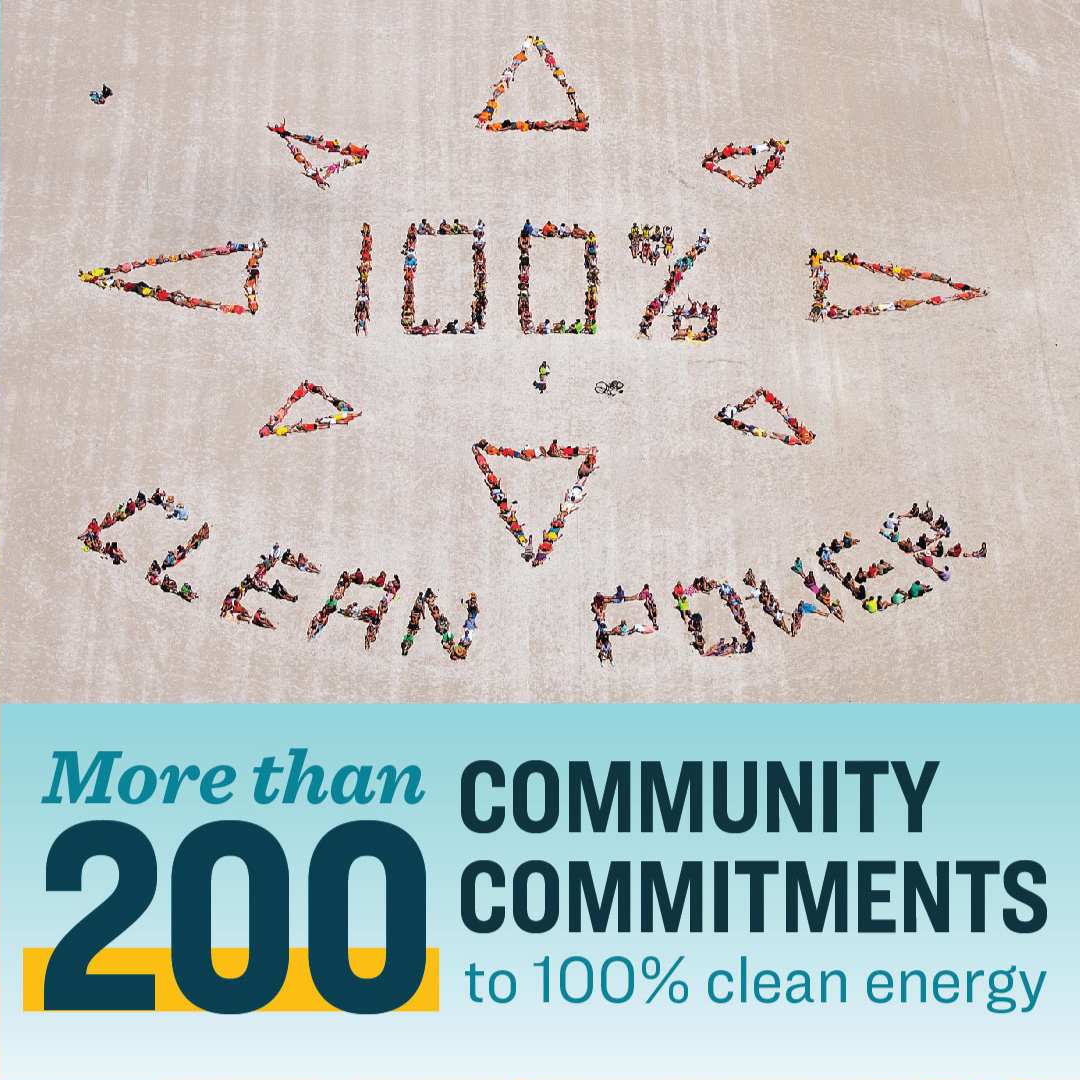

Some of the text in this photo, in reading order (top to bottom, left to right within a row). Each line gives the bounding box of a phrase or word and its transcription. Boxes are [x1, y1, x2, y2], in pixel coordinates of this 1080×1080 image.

[354, 220, 719, 343] 100%
[78, 488, 987, 665] CLEAN POWER
